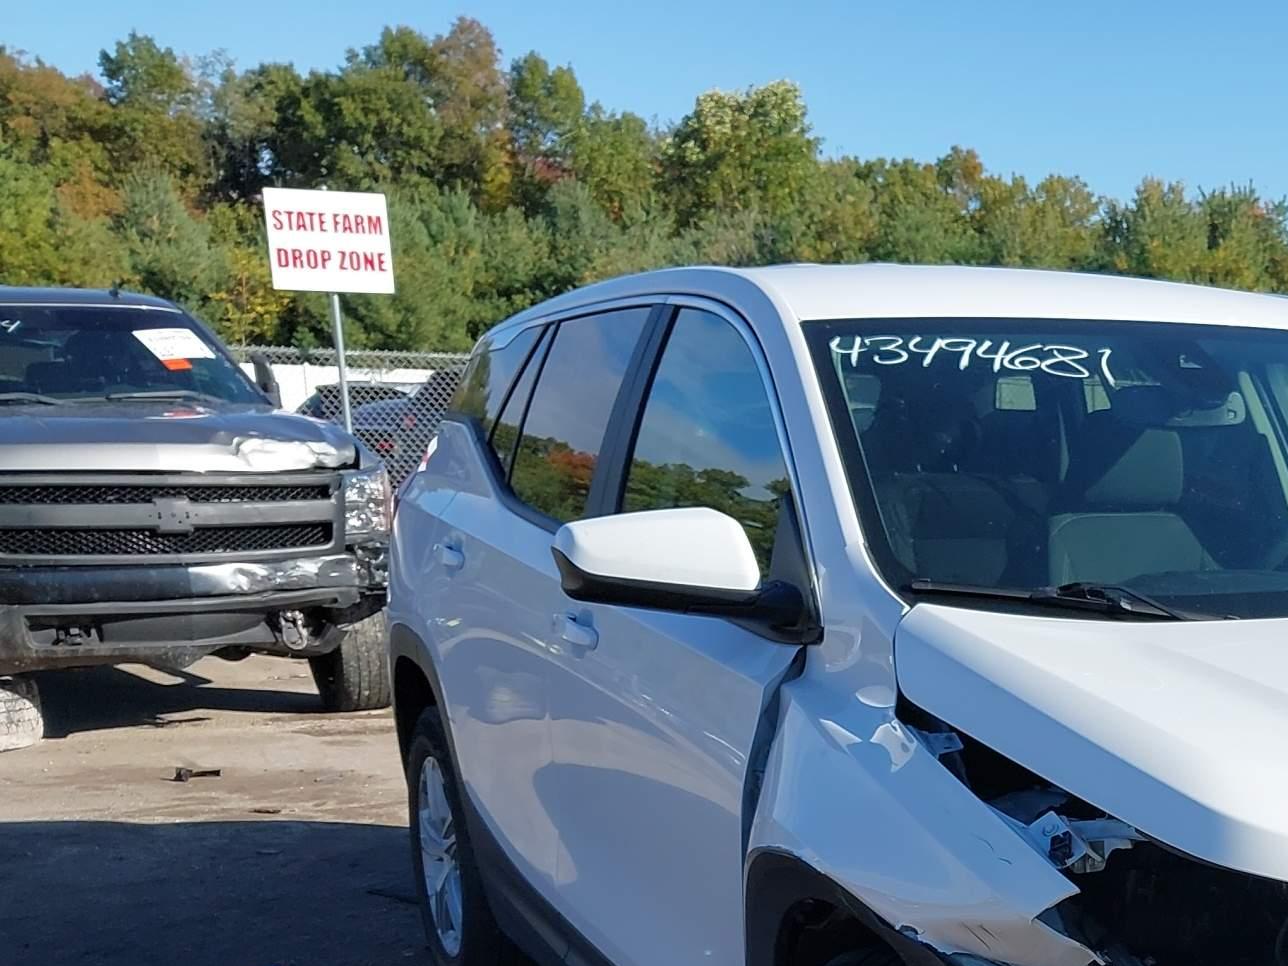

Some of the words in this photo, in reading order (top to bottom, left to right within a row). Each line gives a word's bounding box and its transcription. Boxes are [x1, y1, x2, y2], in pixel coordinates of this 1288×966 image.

[271, 209, 328, 232] STATE
[332, 213, 383, 235] FARM
[276, 247, 332, 269] DROP
[337, 250, 387, 272] ZONE
[829, 335, 1116, 388] 43494681
